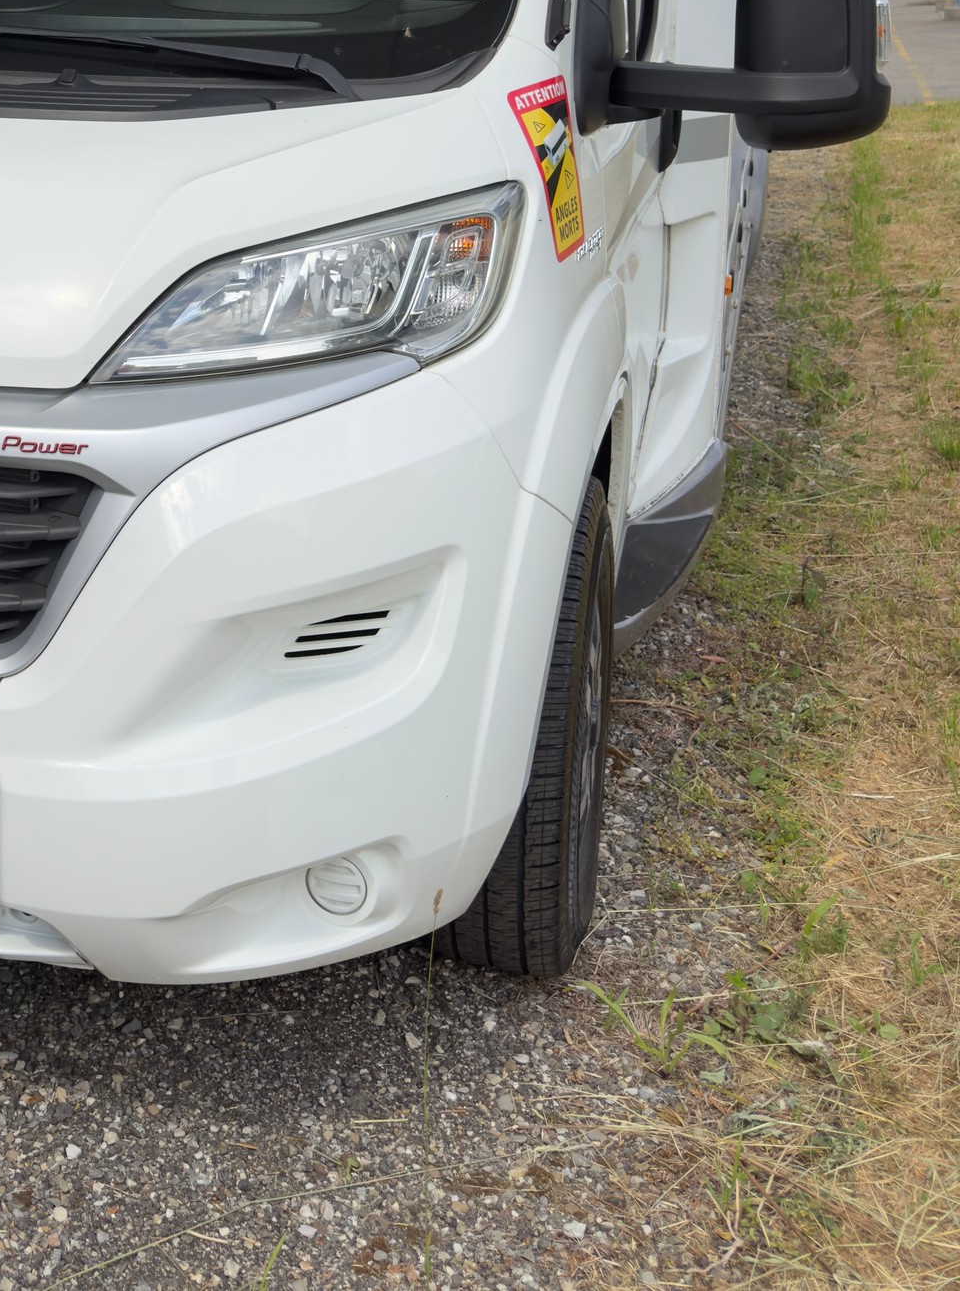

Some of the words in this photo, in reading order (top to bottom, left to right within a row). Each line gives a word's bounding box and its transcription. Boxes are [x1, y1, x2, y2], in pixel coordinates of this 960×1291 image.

[514, 82, 565, 110] ATTENTION
[556, 196, 578, 224] ANGLES
[559, 215, 579, 243] MORTS
[1, 436, 89, 455] Power
